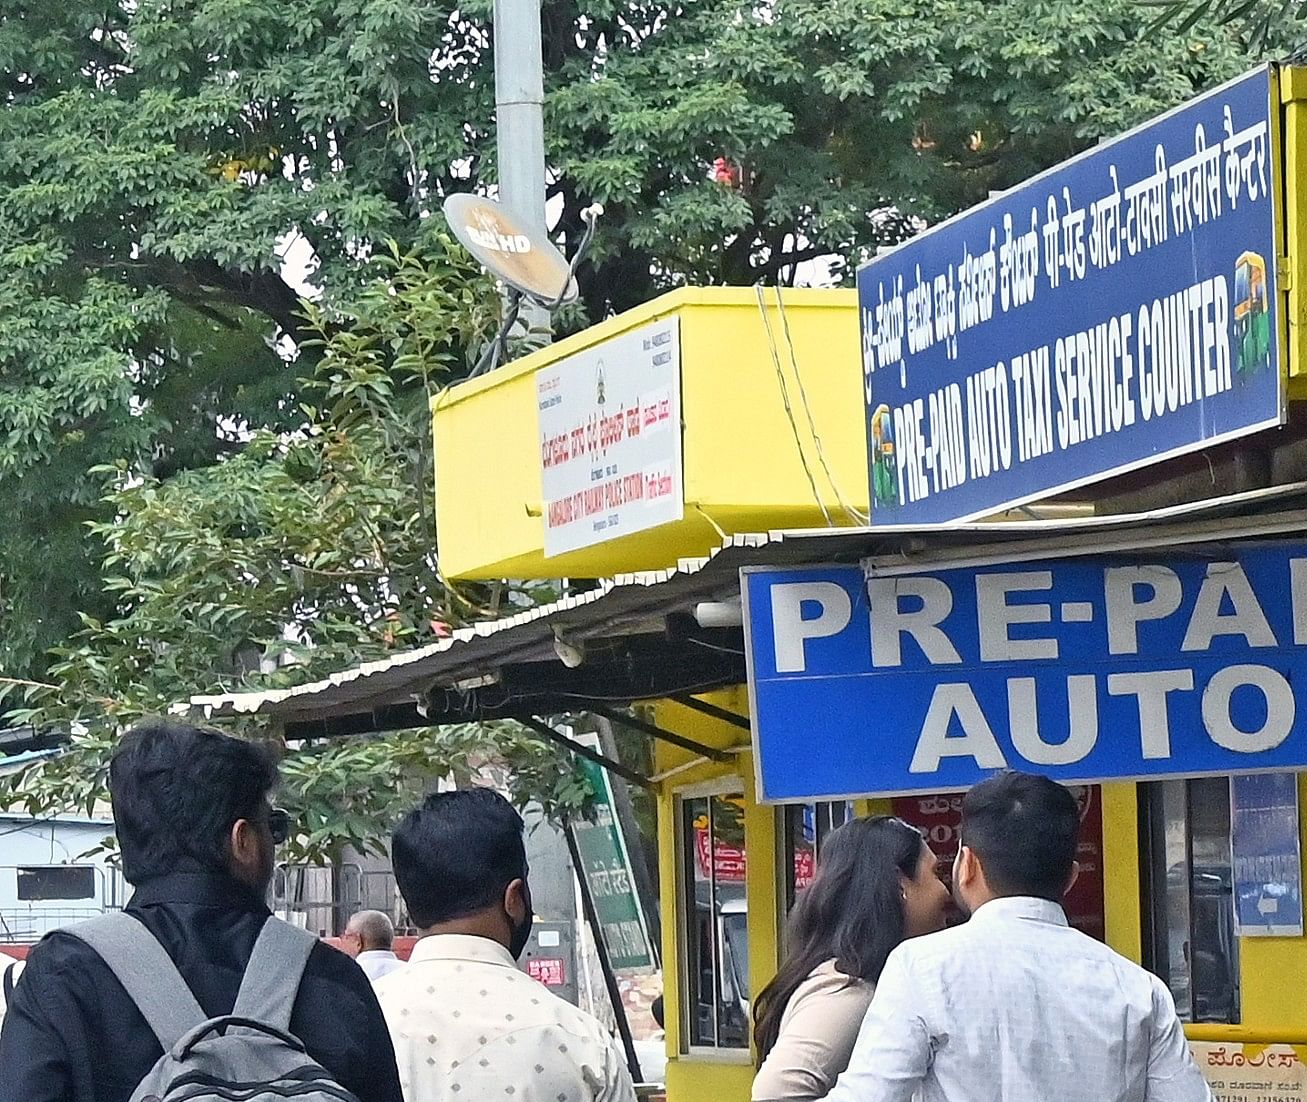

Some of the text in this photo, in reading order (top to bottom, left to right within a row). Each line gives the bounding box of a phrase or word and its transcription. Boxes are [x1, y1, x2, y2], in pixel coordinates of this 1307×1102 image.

[895, 276, 1232, 505] PRE-PAID AUTO TAXI SERVICE COUNTER
[908, 664, 1296, 774] AUTO
